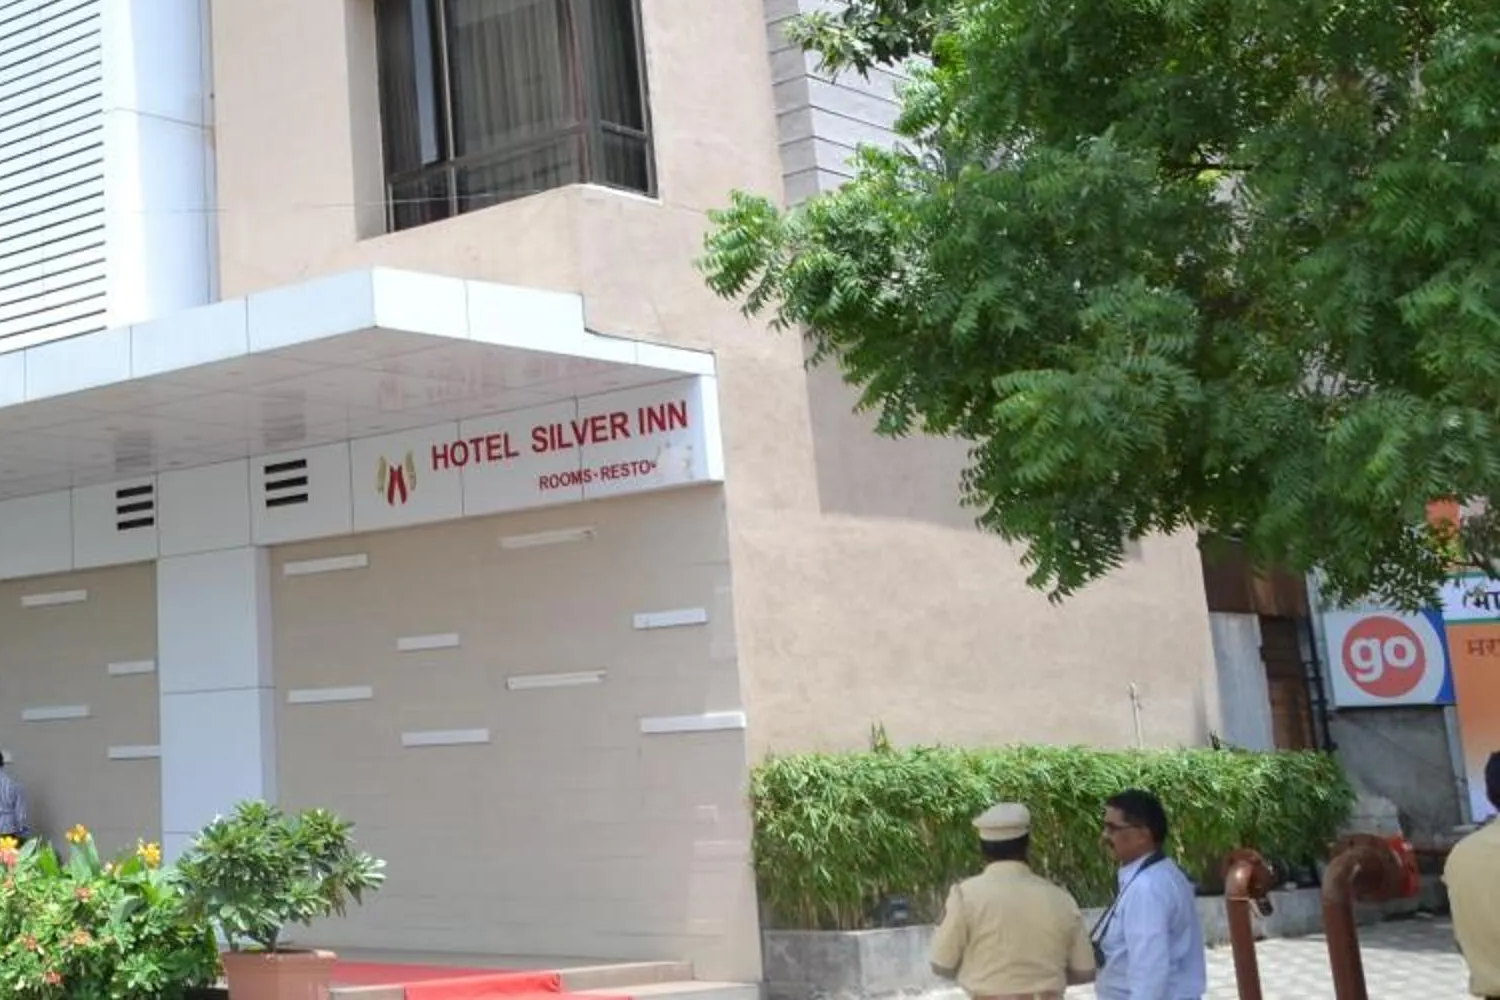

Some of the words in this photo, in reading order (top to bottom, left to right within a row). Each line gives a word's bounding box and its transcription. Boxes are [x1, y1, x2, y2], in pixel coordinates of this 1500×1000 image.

[431, 432, 519, 470] HOTEL
[531, 411, 630, 453] SILVER
[637, 400, 688, 435] INN
[1350, 634, 1417, 683] go
